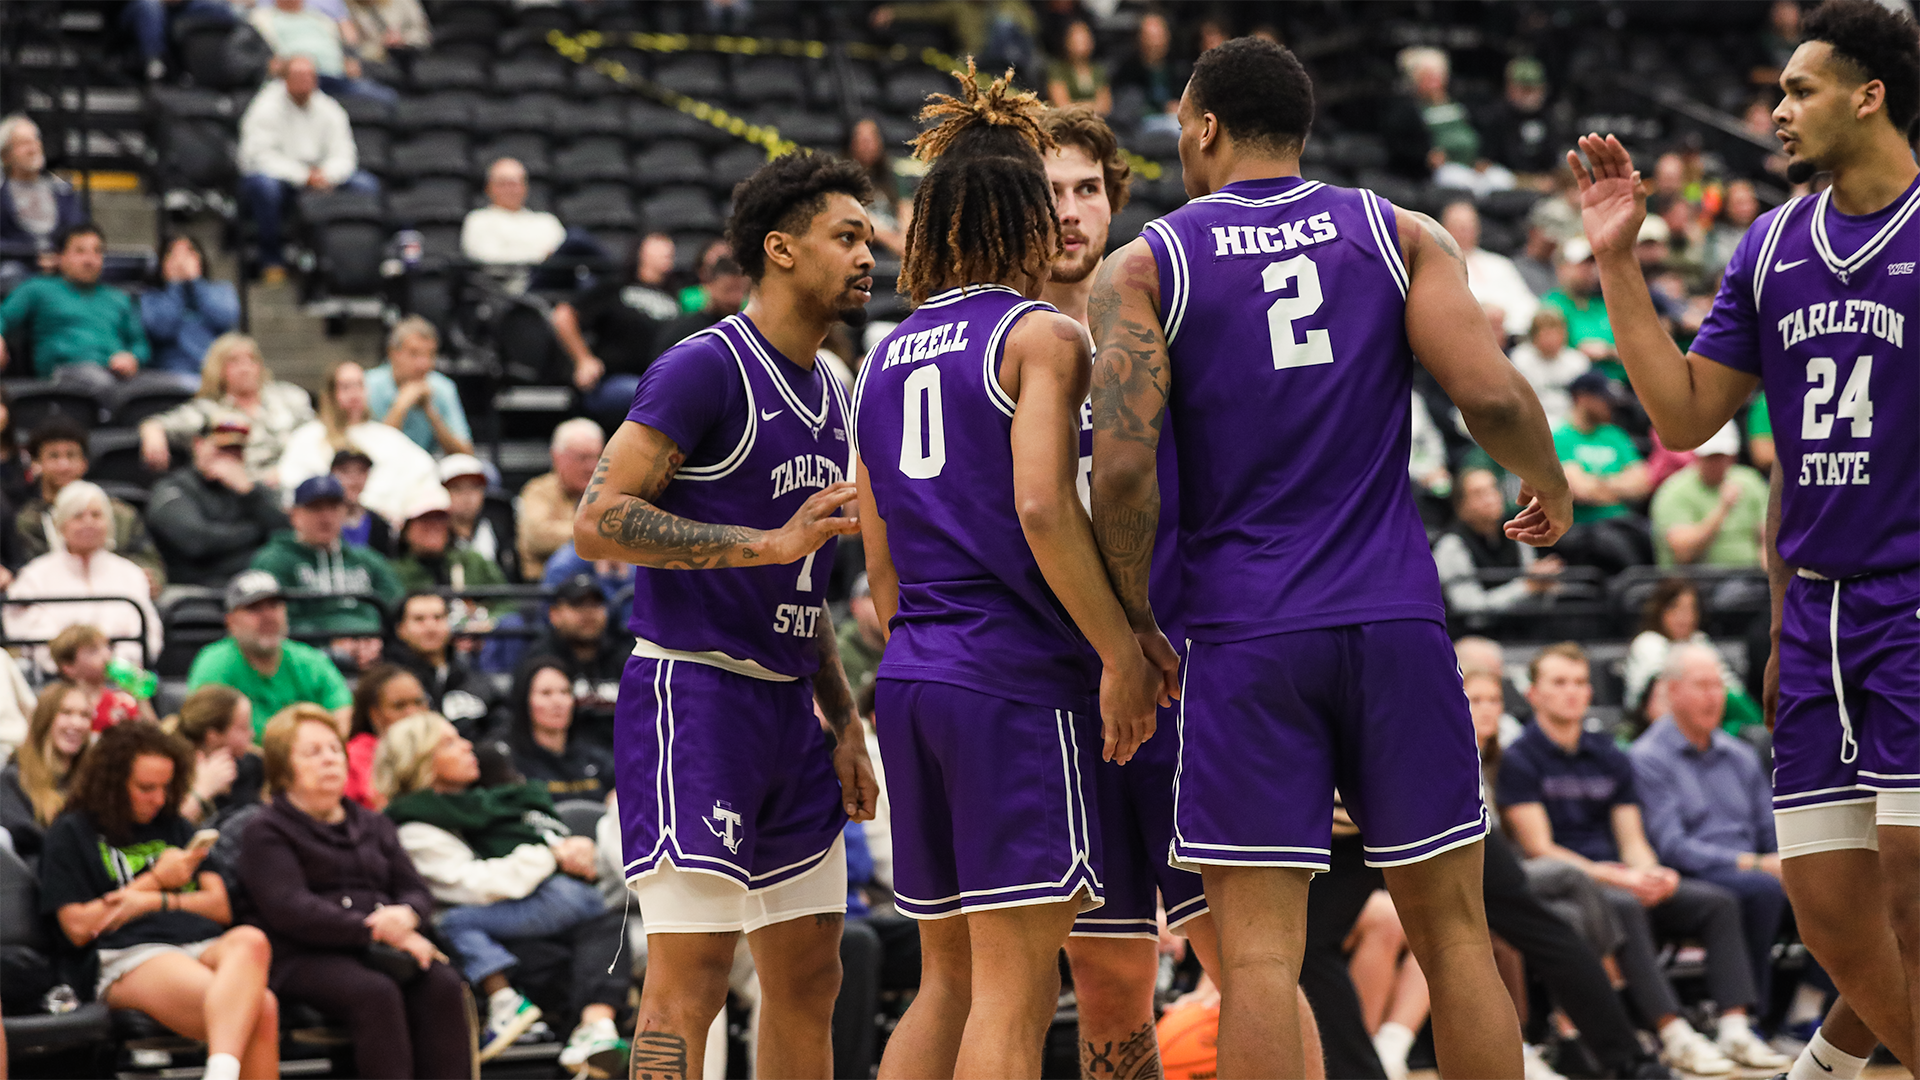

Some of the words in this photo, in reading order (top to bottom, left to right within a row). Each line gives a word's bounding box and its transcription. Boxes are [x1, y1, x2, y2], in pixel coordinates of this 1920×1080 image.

[1211, 211, 1338, 256] HICKS
[1887, 261, 1916, 275] WAC
[1261, 253, 1334, 370] 2
[1778, 299, 1905, 350] TARLETON
[881, 320, 969, 371] MIZELL
[899, 363, 946, 479] 0
[1801, 355, 1873, 440] 24
[1799, 451, 1870, 486] STATE
[773, 603, 822, 638] STAT
